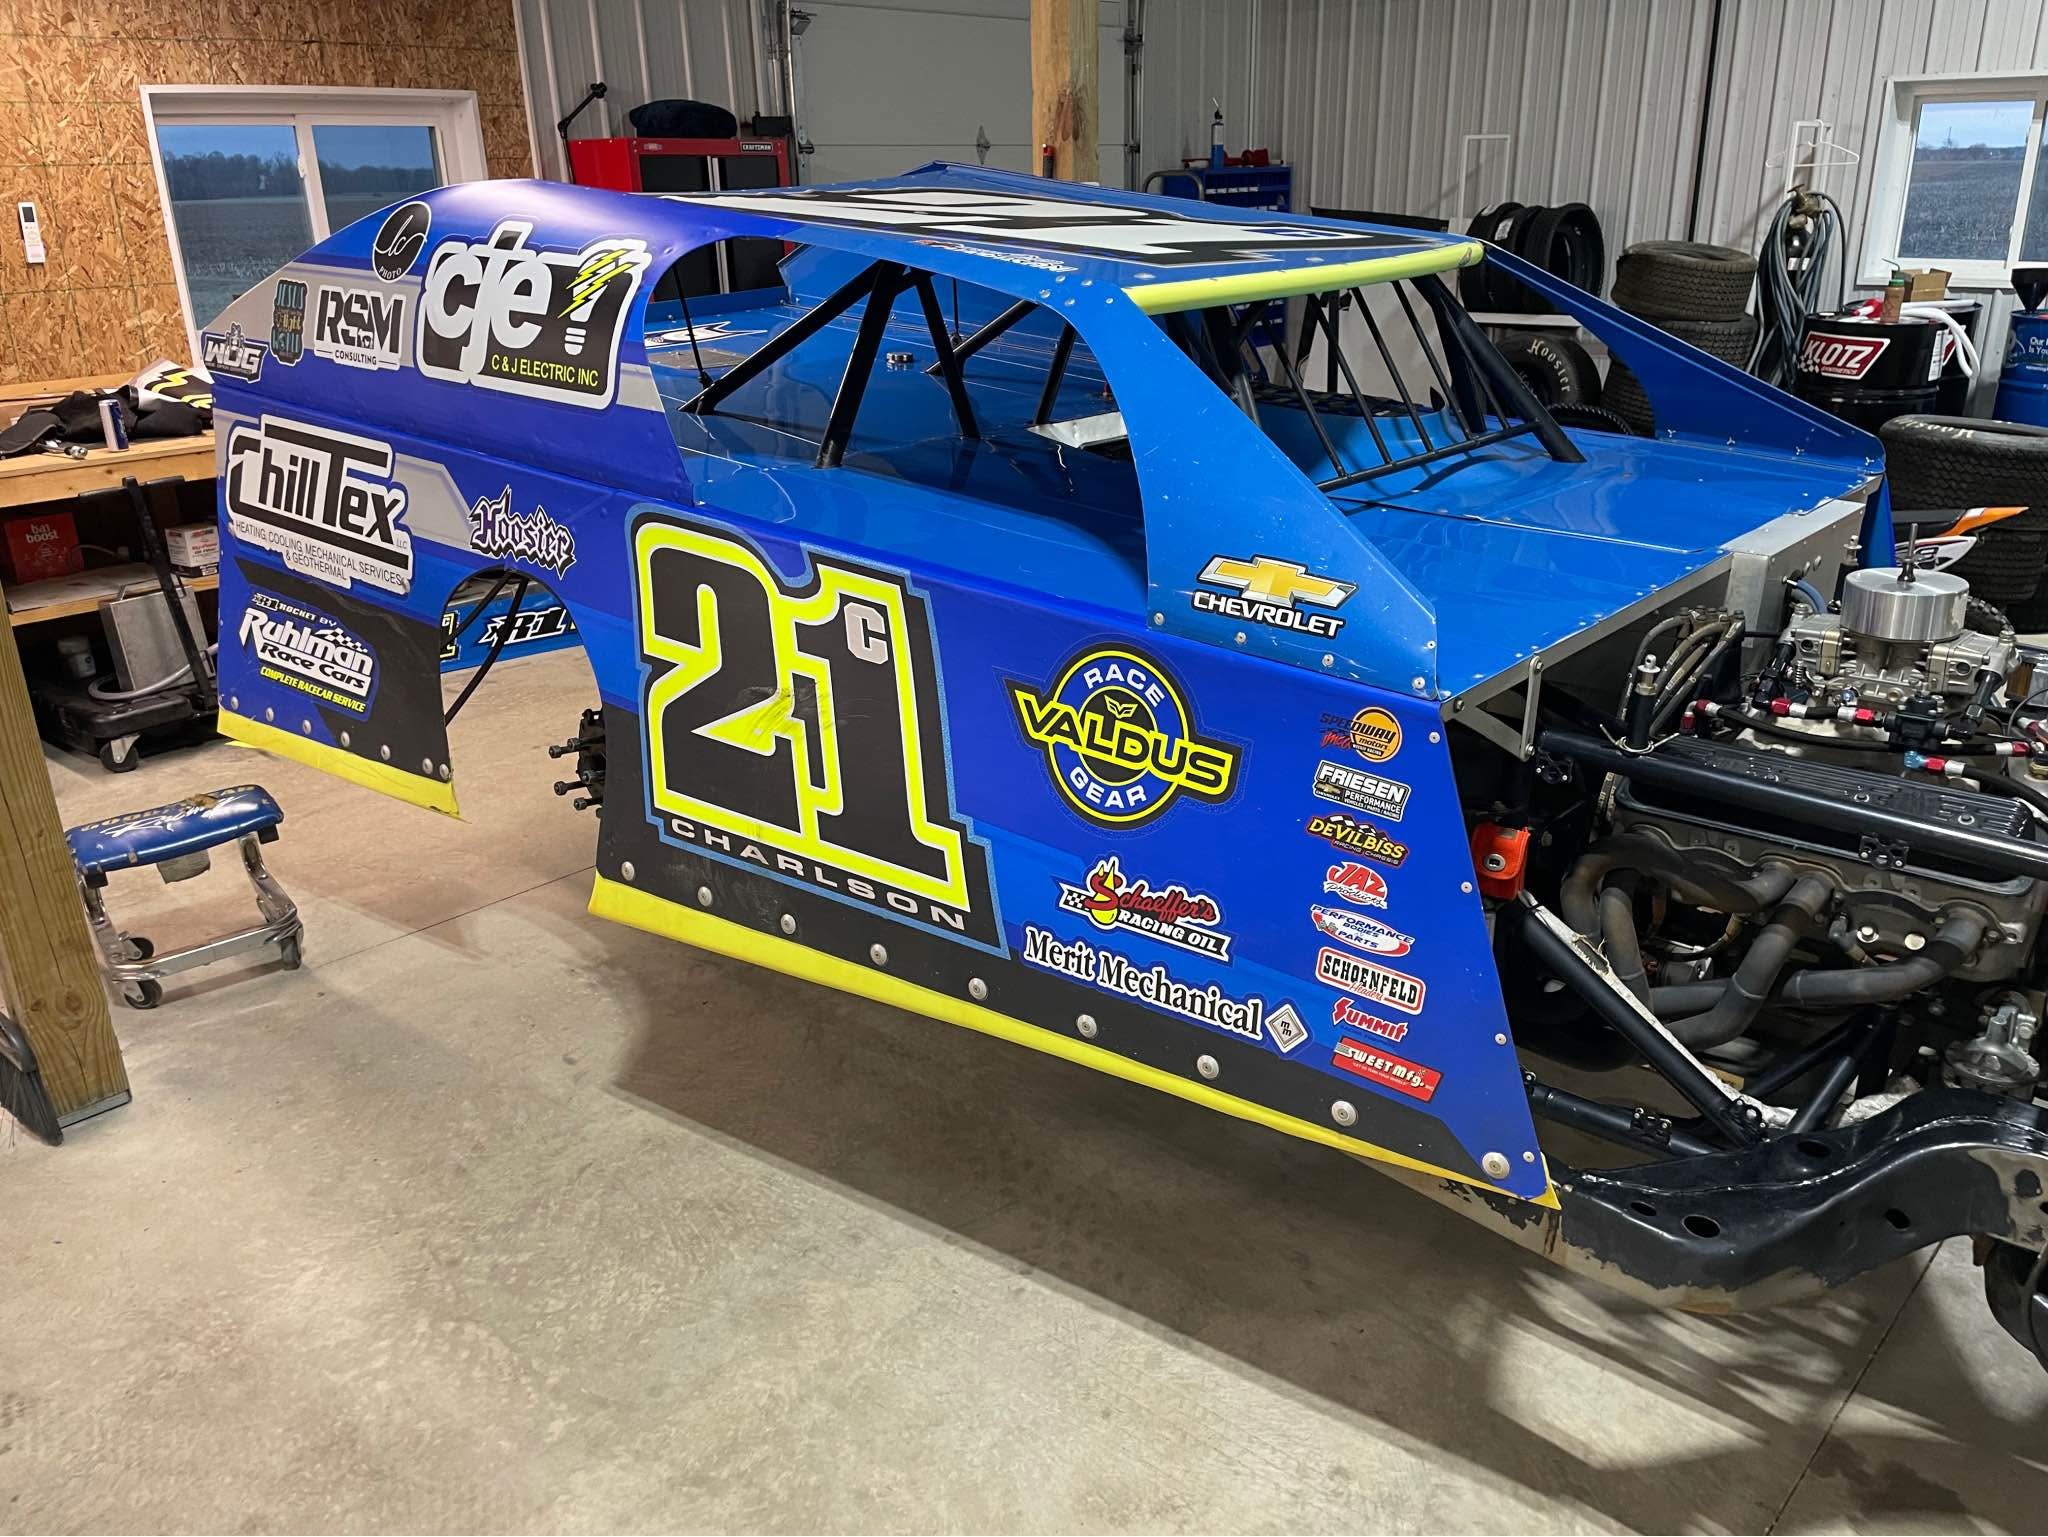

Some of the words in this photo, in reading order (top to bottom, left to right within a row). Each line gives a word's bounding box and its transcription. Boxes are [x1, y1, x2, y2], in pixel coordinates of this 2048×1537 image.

[379, 265, 402, 280] PHOTO
[316, 289, 404, 354] RSM
[334, 349, 377, 366] CONSULTING
[491, 354, 500, 370] C
[501, 356, 509, 371] &
[511, 357, 518, 374] J
[519, 358, 576, 383] ELECTRIC
[577, 367, 599, 387] INC
[1803, 339, 1874, 369] KLOTZ
[229, 423, 409, 570] ChillTex
[468, 486, 575, 577] Hoosier
[285, 550, 291, 561] &
[292, 551, 348, 581] GEOTHERMAL
[305, 543, 358, 572] MECHANICAL
[359, 561, 402, 586] SERVICES
[280, 602, 317, 621] ROCKET
[319, 616, 337, 627] BY
[843, 601, 890, 666] C
[1192, 591, 1345, 638] CHEVROLET
[238, 607, 374, 677] Ruhlman
[260, 642, 316, 670] Race
[318, 663, 366, 689] Cars
[1082, 663, 1166, 707] RACE
[260, 666, 299, 688] COMPLETE
[298, 679, 333, 701] RACECAR
[333, 692, 367, 713] SERVICE
[635, 521, 972, 913] 21
[1013, 688, 1234, 797] VALDUS
[1068, 765, 1148, 810] GEAR
[1319, 764, 1405, 803] FRIESEN
[1344, 789, 1402, 814] PERFORMANCE
[1308, 818, 1406, 860] DEVILBISS
[1333, 839, 1362, 853] RACING
[669, 816, 967, 933] CHARLSON
[1325, 882, 1385, 907] Products
[1328, 863, 1386, 899] JAZ
[1084, 870, 1217, 923] Schaeffer's
[1116, 909, 1185, 941] RACING
[1187, 933, 1220, 953] OIL
[1312, 905, 1415, 944] PERFORMANCE
[1338, 930, 1379, 948] PARTS
[1343, 922, 1379, 938] BODIES
[1026, 928, 1094, 978] Merit
[1099, 953, 1261, 1037] Mechanical
[1323, 954, 1418, 1004] SCHOENFELD
[1349, 1048, 1393, 1073] SWEET
